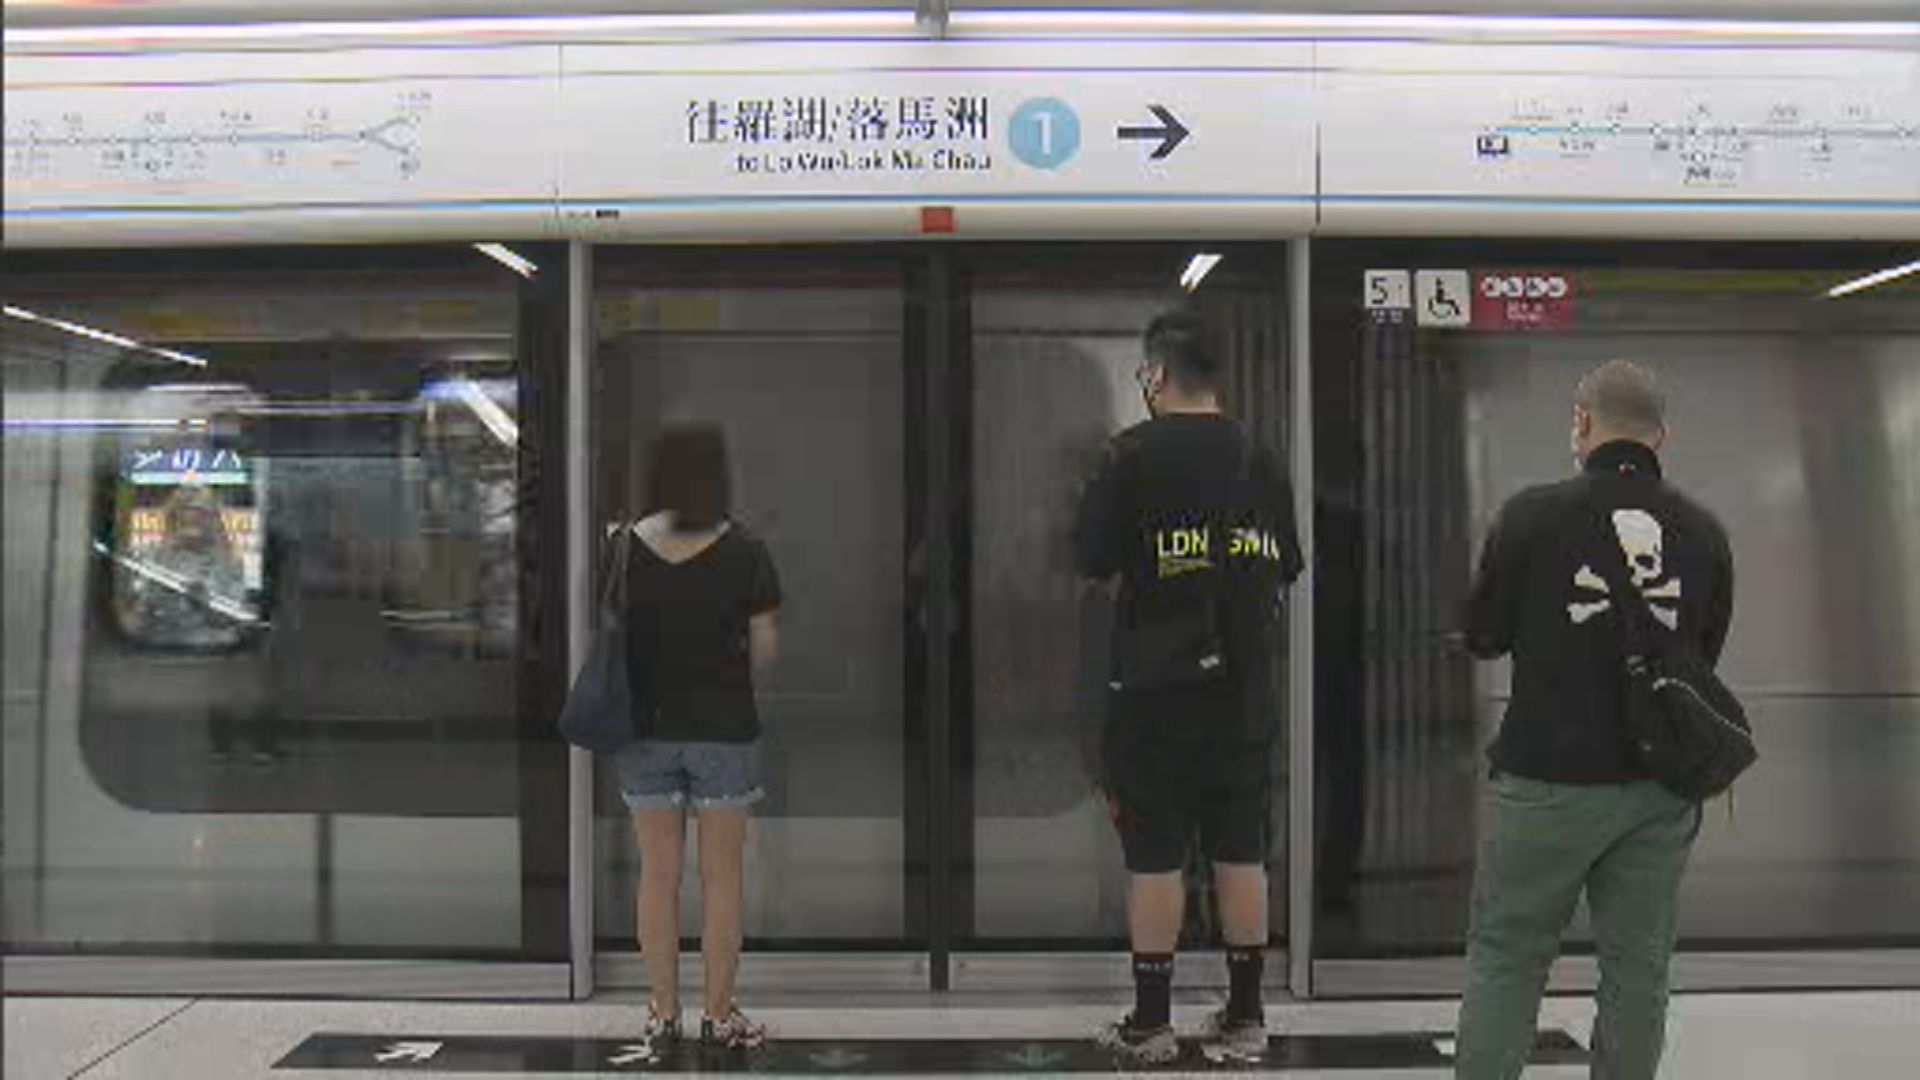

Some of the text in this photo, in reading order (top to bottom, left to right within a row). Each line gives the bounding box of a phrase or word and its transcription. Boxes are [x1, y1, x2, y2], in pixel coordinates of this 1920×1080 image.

[737, 154, 758, 172] to
[764, 152, 793, 173] Lo
[932, 149, 989, 170] Chau
